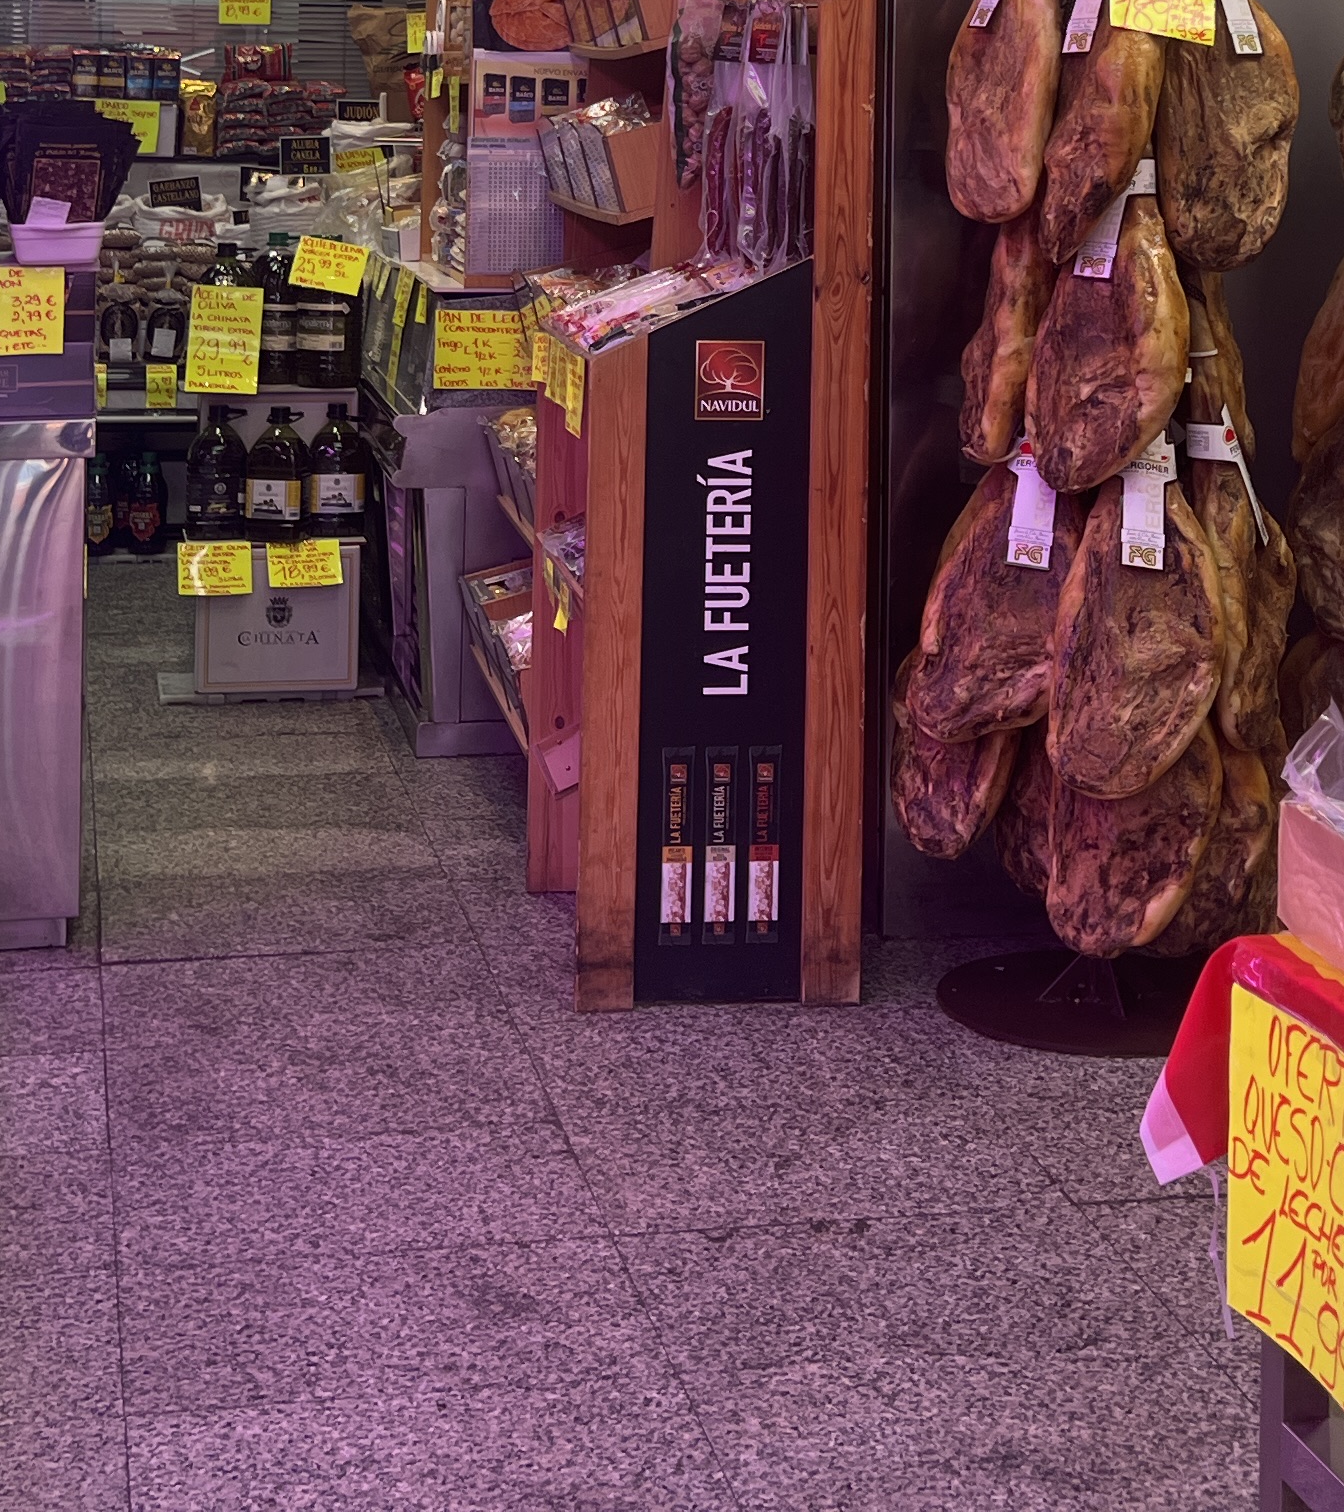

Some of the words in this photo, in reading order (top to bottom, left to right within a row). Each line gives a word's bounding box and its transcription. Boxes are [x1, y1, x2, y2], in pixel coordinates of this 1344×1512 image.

[153, 190, 199, 203] CASTELLANO
[9, 268, 25, 278] DE
[193, 287, 234, 301] ACEITE
[242, 293, 258, 301] DE
[46, 295, 56, 307] €
[198, 301, 237, 311] OLIVA
[46, 310, 57, 321] €
[192, 314, 205, 322] LA
[207, 314, 252, 323] CHINATA
[438, 311, 461, 323] PAN
[470, 313, 485, 323] DE
[228, 326, 255, 336] EXTRA
[197, 365, 206, 377] 5
[207, 368, 243, 379] LITROS
[700, 398, 761, 414] NAVIDUL
[696, 448, 754, 632] FUETERÍA
[702, 645, 749, 696] LA
[1228, 1137, 1266, 1195] DE
[1311, 1248, 1338, 1300] POR
